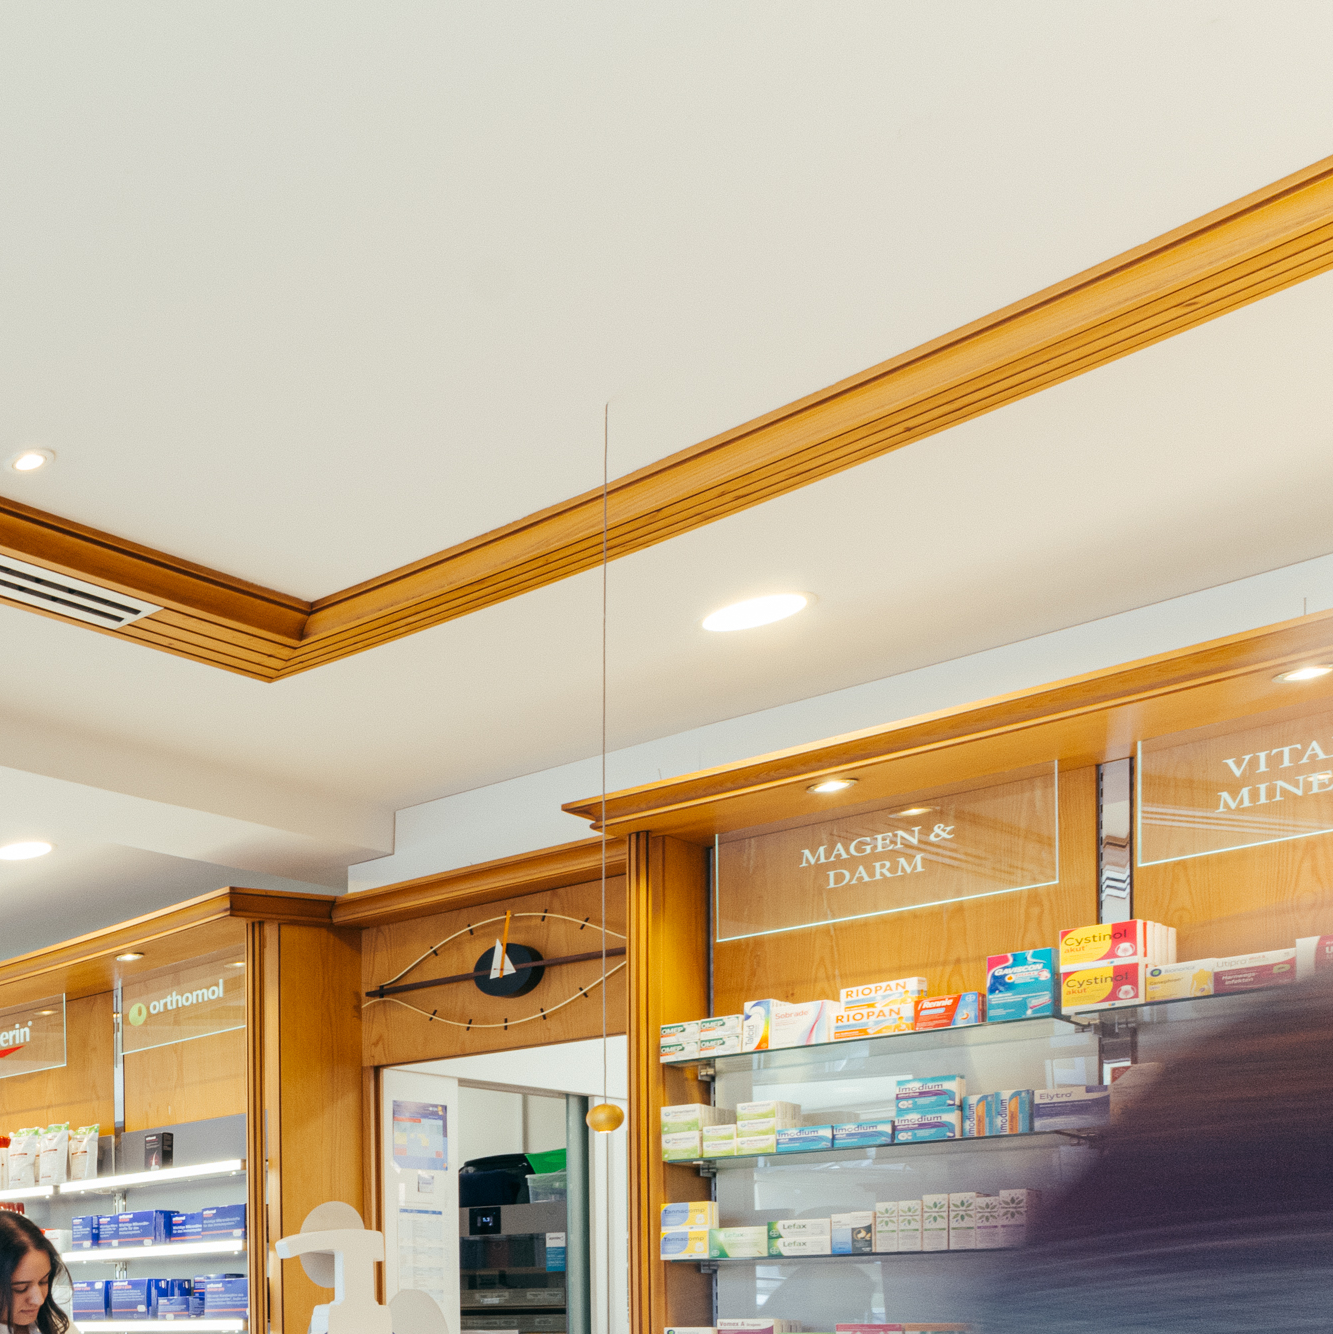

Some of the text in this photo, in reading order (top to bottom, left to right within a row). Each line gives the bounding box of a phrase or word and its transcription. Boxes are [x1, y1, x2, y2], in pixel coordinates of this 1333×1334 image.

[1222, 738, 1333, 778] VITA
[799, 822, 954, 869] MAGEN &
[825, 853, 926, 890] DARM
[1064, 929, 1127, 948] Cystinol
[1064, 945, 1086, 955] akut
[1215, 957, 1248, 970] Utipro
[994, 963, 1043, 977] GAVISCON
[1065, 971, 1130, 989] Cystinol
[845, 981, 907, 999] RIOPAN
[1065, 986, 1088, 996] akut
[149, 979, 224, 1014] orthomol
[918, 997, 954, 1011] Rennie
[775, 1009, 810, 1020] Sobrade
[835, 1007, 901, 1025] RIOPAN
[700, 1019, 725, 1029] OMEP
[661, 1026, 683, 1036] OMEP
[745, 1024, 754, 1047] Talcid
[700, 1038, 725, 1048] OMEP
[661, 1045, 684, 1055] OMEP
[898, 1083, 943, 1093] Imodium
[1039, 1091, 1071, 1100] Elytro
[897, 1114, 943, 1124] Imodium
[777, 1128, 819, 1138] Imodium
[834, 1124, 878, 1134] Imodium
[663, 1207, 705, 1215] Tannacomp
[782, 1222, 807, 1230] Lefax
[663, 1235, 705, 1243] Tannacomp
[782, 1240, 807, 1248] Lefax
